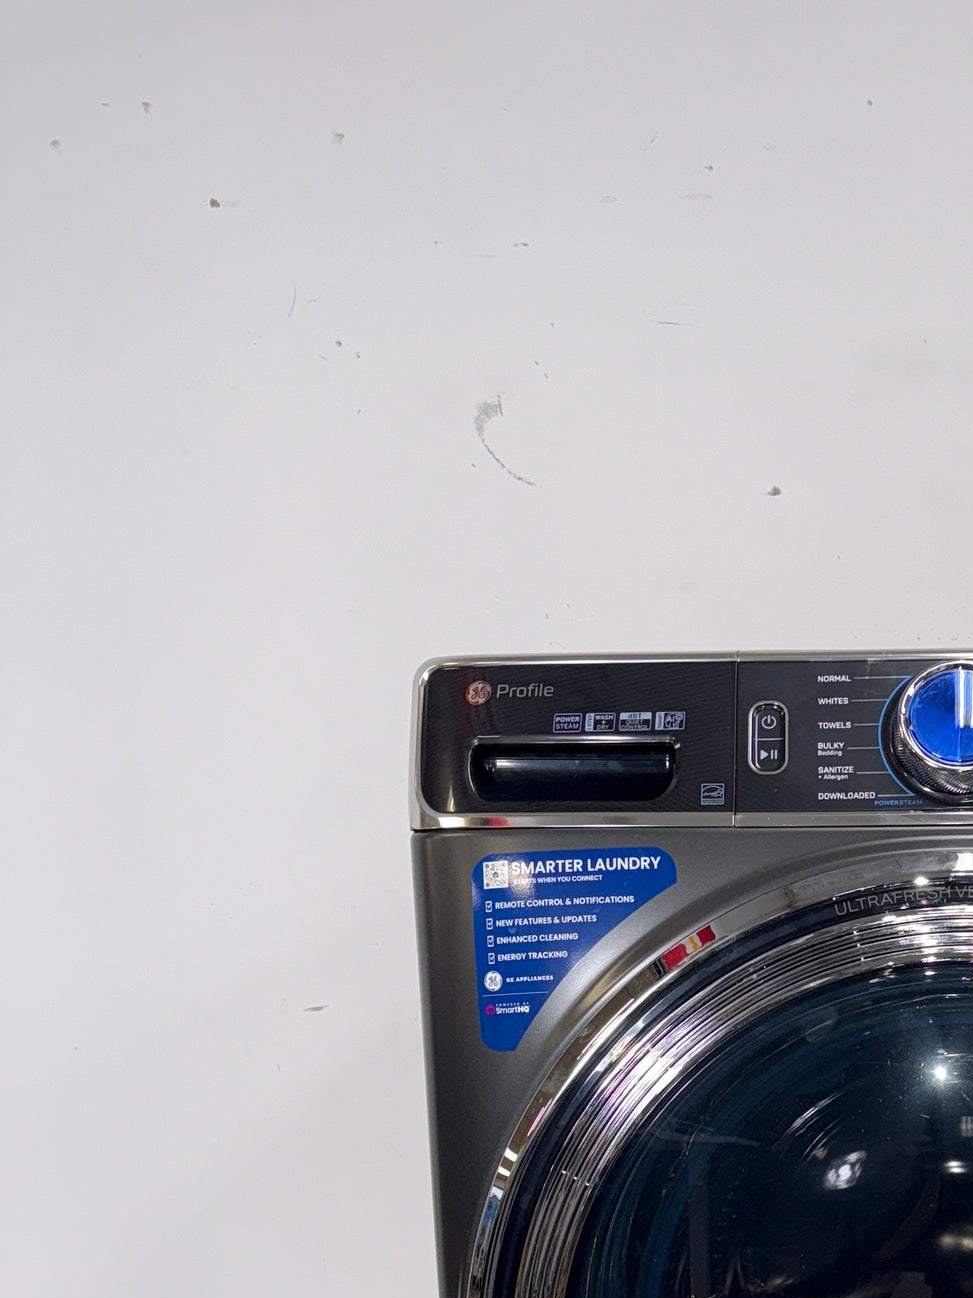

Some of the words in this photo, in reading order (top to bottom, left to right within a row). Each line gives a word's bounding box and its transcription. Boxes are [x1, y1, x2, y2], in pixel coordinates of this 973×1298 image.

[817, 675, 852, 683] NORMAL
[496, 683, 554, 699] Profile
[817, 697, 849, 705] WHITES
[817, 721, 852, 729] TOWELS
[817, 742, 845, 750] BULKY
[817, 766, 855, 774] SANITIZE
[817, 791, 876, 800] DOWNLOADED
[511, 858, 583, 875] SMARTER
[587, 856, 661, 872] LAUNDRY
[495, 900, 526, 910] REMOTE
[526, 898, 564, 908] CONTROL
[573, 895, 635, 905] NOTIFICATIONS
[834, 886, 951, 916] ULTRAFRESH
[496, 919, 513, 927] NEW
[514, 917, 552, 926] FEATURES
[554, 916, 560, 924] &
[561, 914, 597, 923] UPDATES
[496, 934, 538, 944] ENHANCED
[539, 932, 579, 942] CLEANING
[497, 952, 527, 961] ENERGY
[528, 950, 568, 960] TRACKING
[515, 975, 554, 983] APPLIANCES
[495, 1005, 530, 1015] SmartHQ
